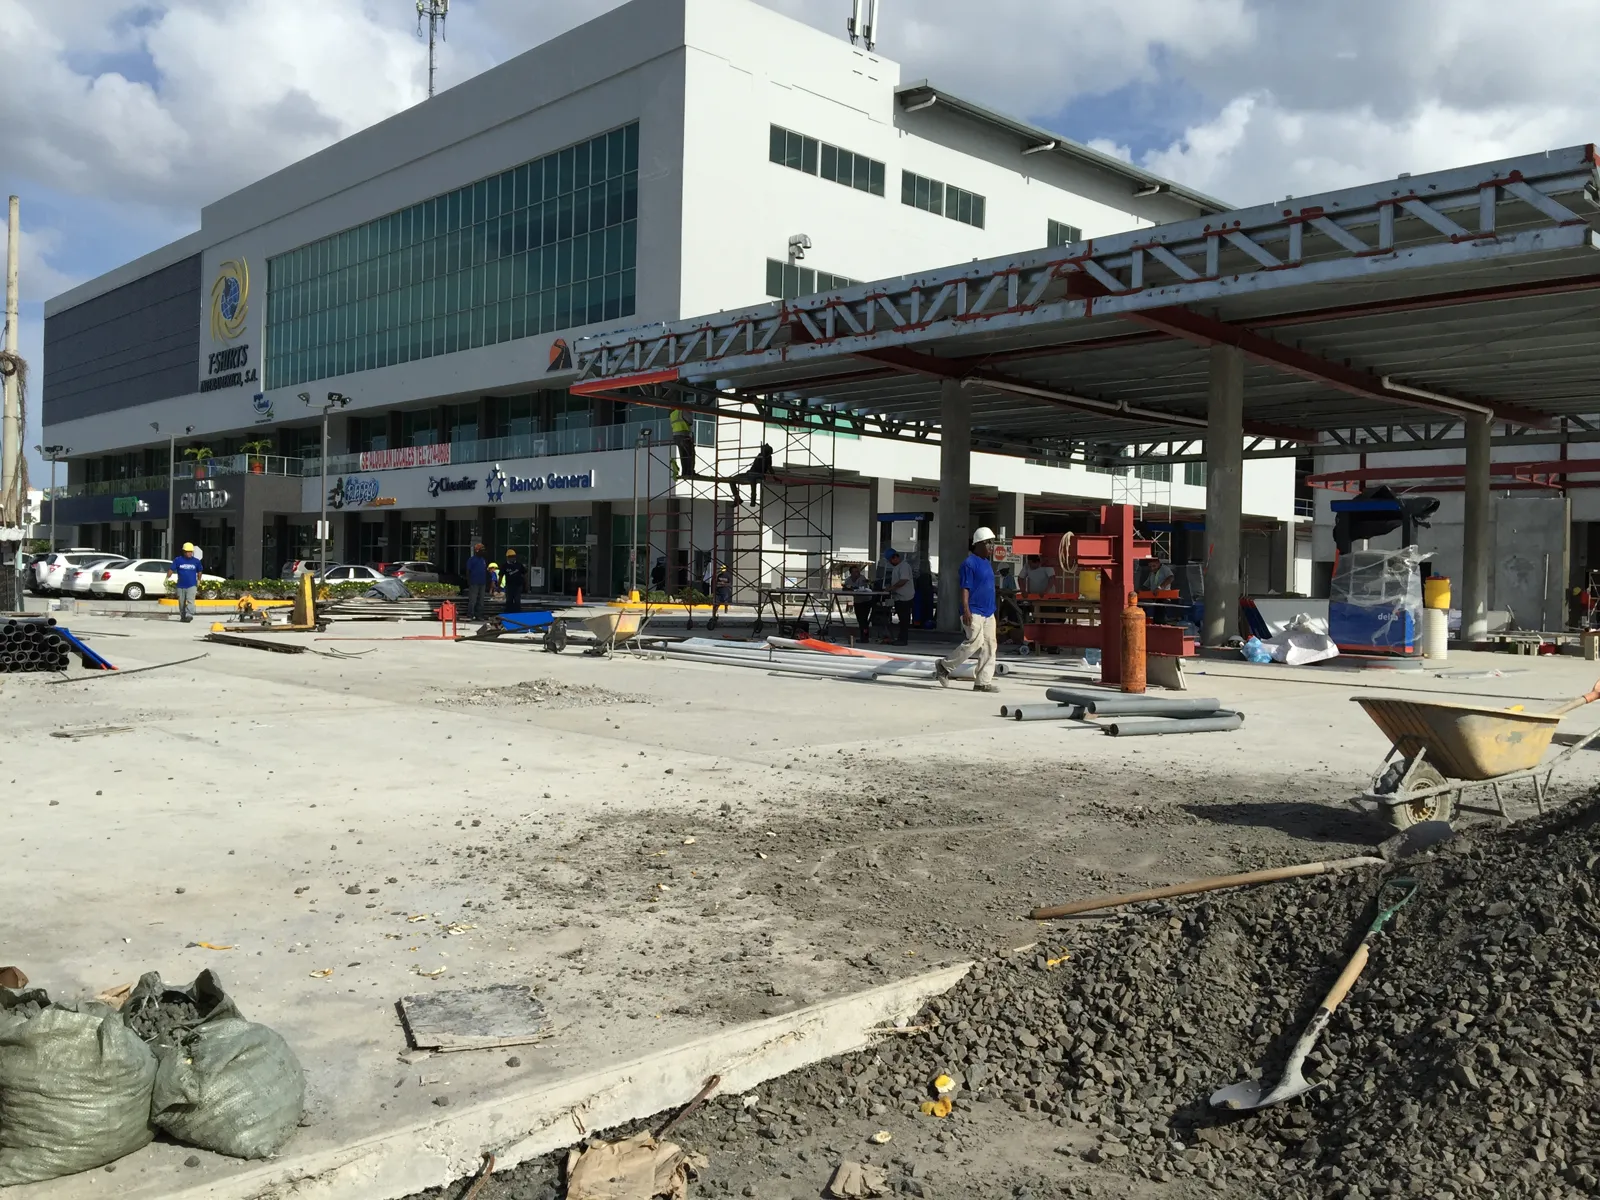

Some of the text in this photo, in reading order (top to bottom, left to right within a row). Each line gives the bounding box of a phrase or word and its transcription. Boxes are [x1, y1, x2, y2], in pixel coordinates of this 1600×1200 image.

[208, 344, 249, 374] T-SHIRTS
[510, 469, 593, 492] Banco General
